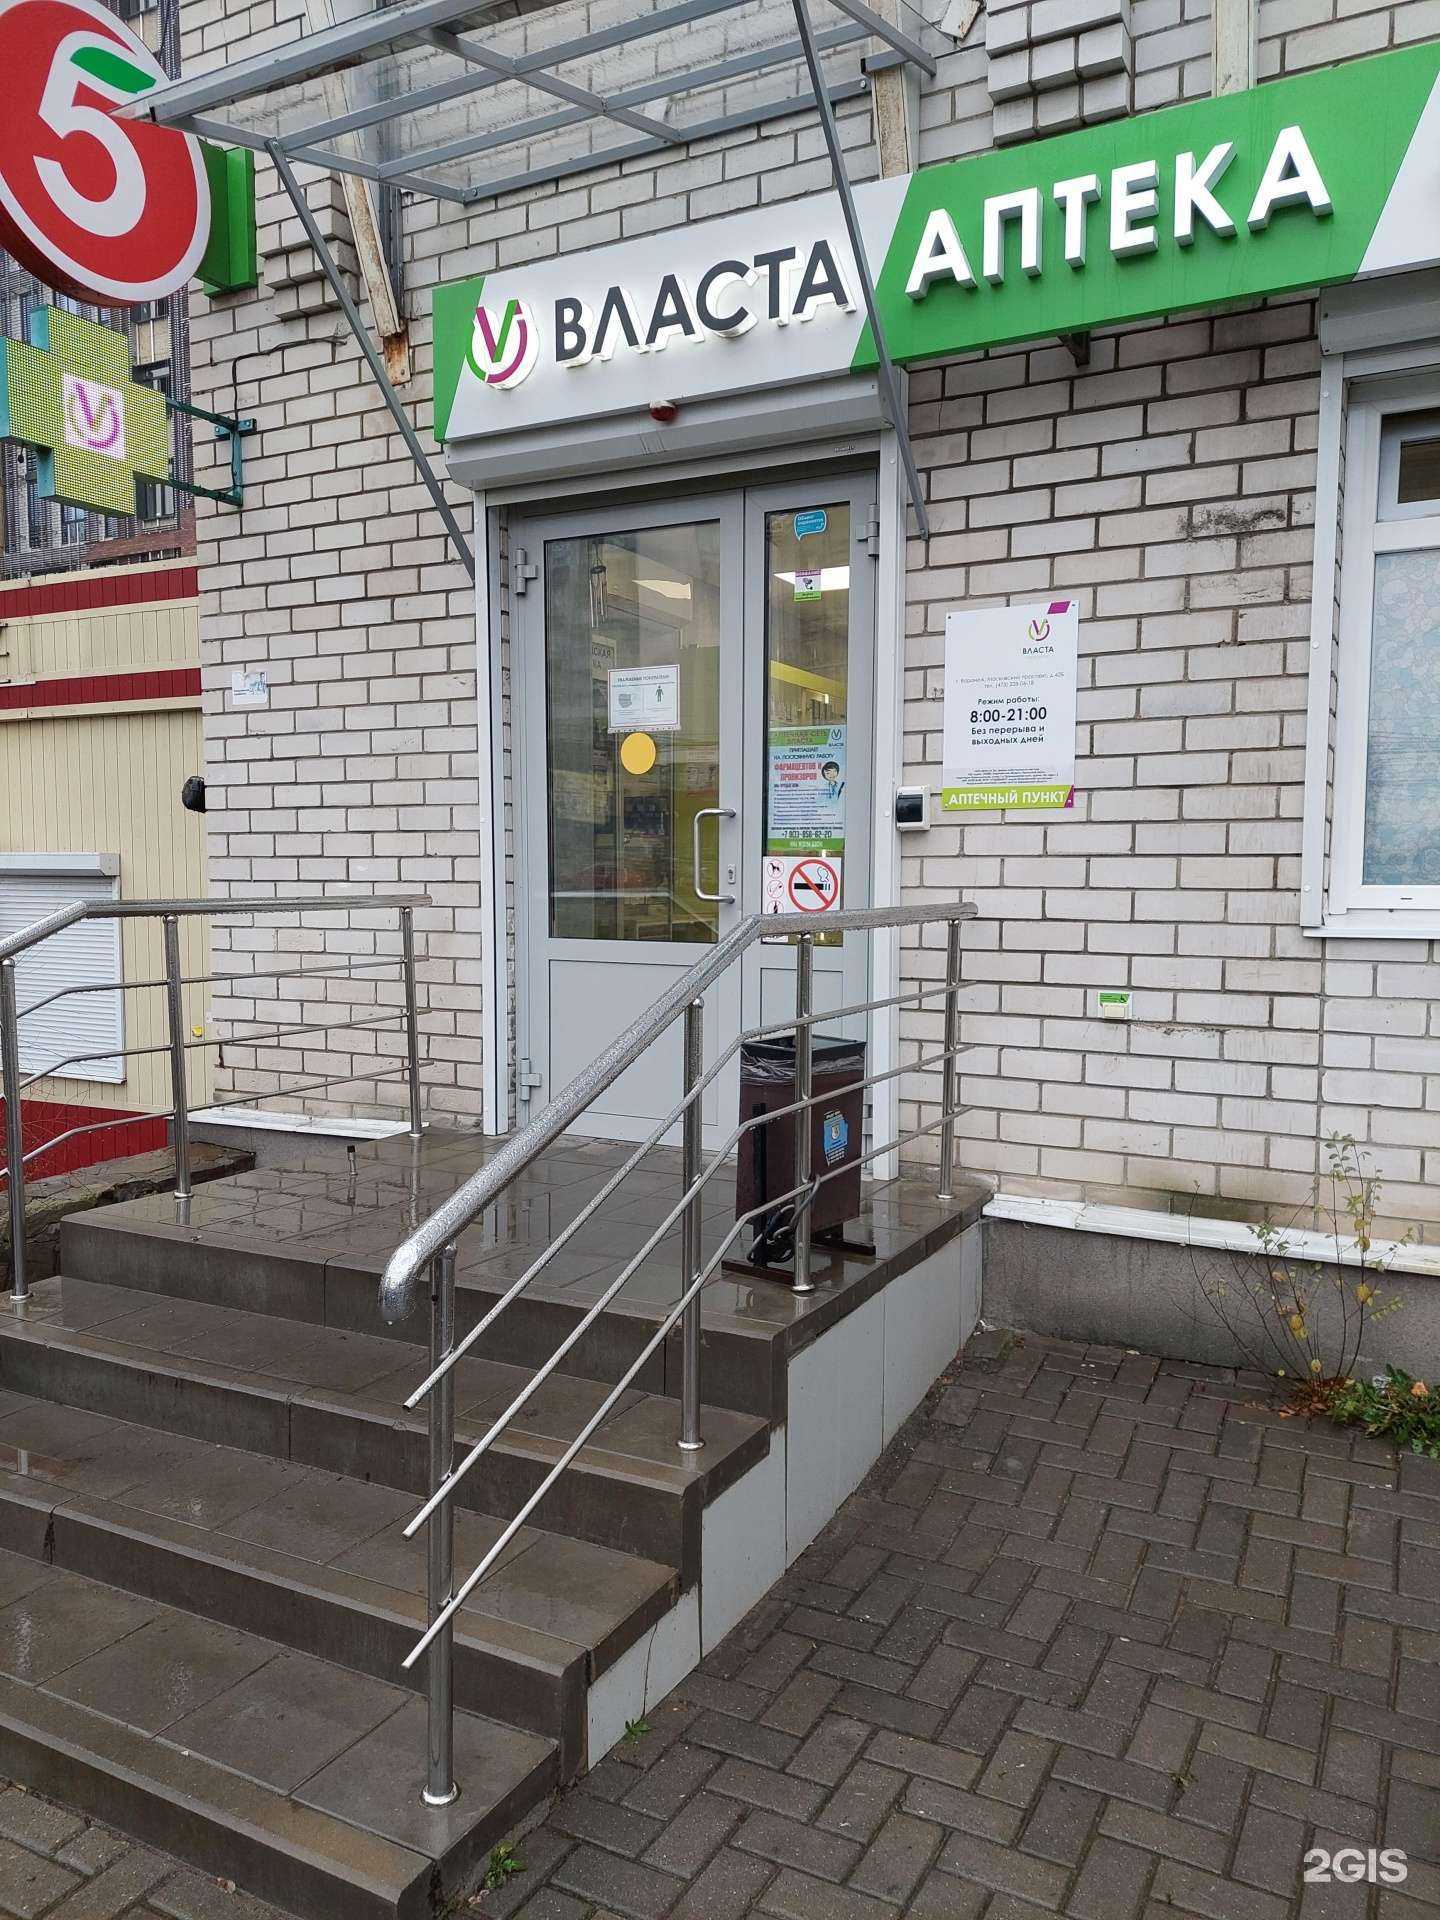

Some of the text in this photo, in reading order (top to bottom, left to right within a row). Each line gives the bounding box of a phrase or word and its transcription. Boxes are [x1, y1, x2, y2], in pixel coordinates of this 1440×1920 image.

[904, 125, 1333, 301] АПТЕКА
[554, 239, 855, 366] ВЛАСТА
[1023, 646, 1054, 655] ВЛАСТА
[1006, 696, 1040, 705] работы:
[970, 707, 1047, 723] 8:00-21:00
[971, 727, 986, 735] Без
[988, 726, 1037, 735] перерыва
[971, 735, 1044, 746] выходных дней
[949, 790, 1065, 805] АПТЕЧНЫЙ ПУНКТ
